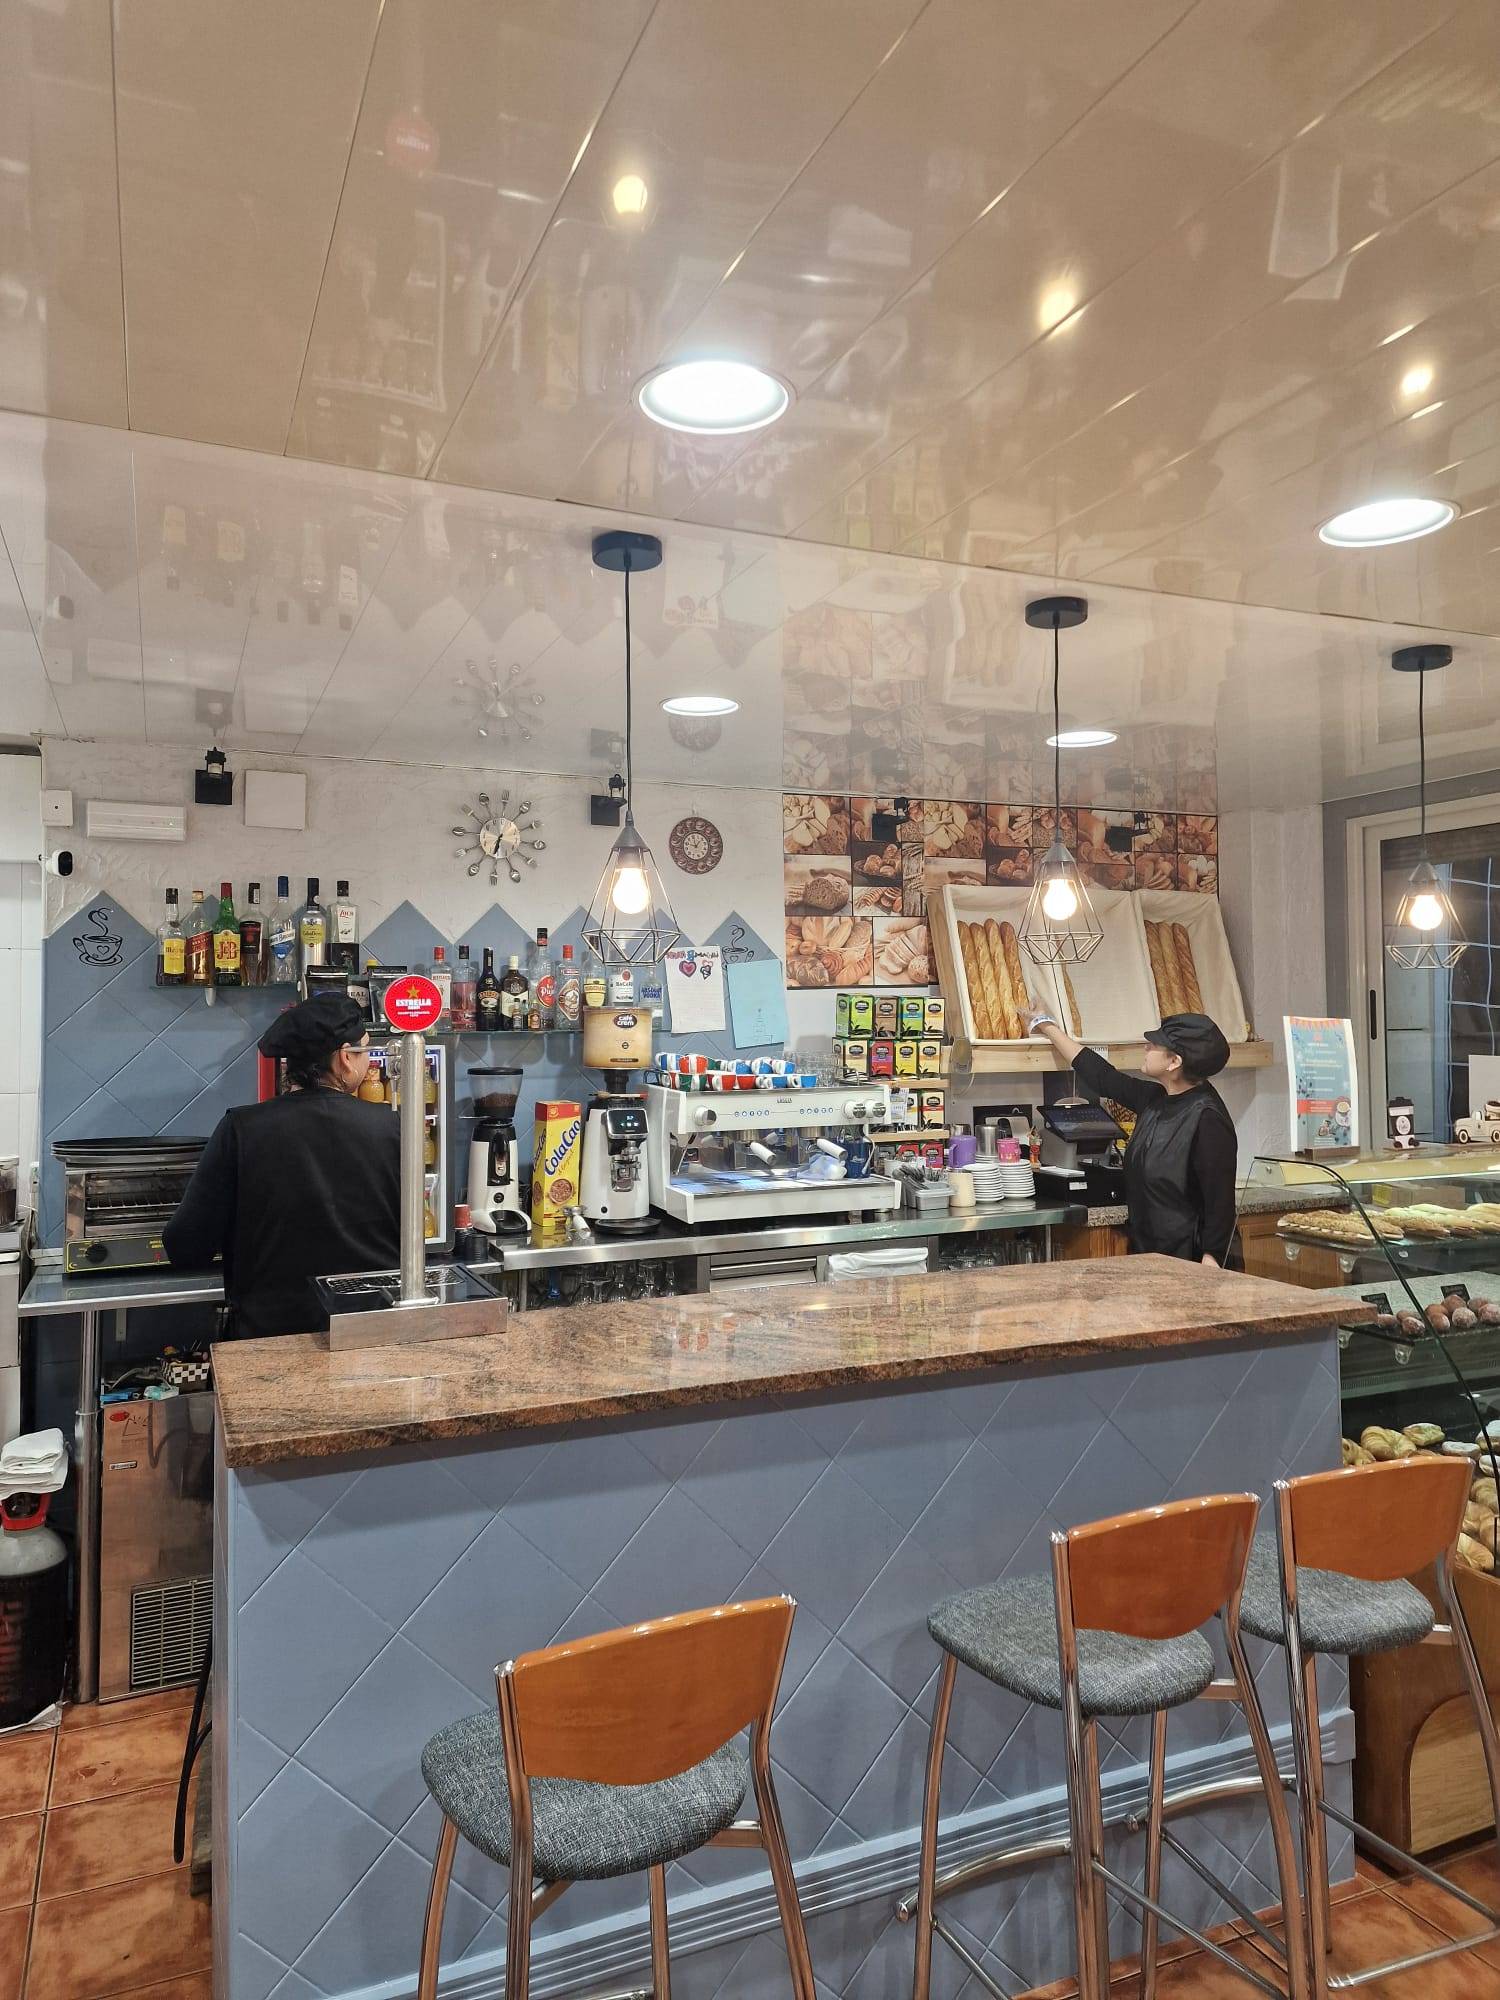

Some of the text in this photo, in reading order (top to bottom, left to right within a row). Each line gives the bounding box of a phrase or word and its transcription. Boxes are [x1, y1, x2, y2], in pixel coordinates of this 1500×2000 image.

[216, 941, 237, 960] J&B
[396, 998, 432, 1007] ESTRELLA
[544, 1119, 581, 1176] ColaCao
